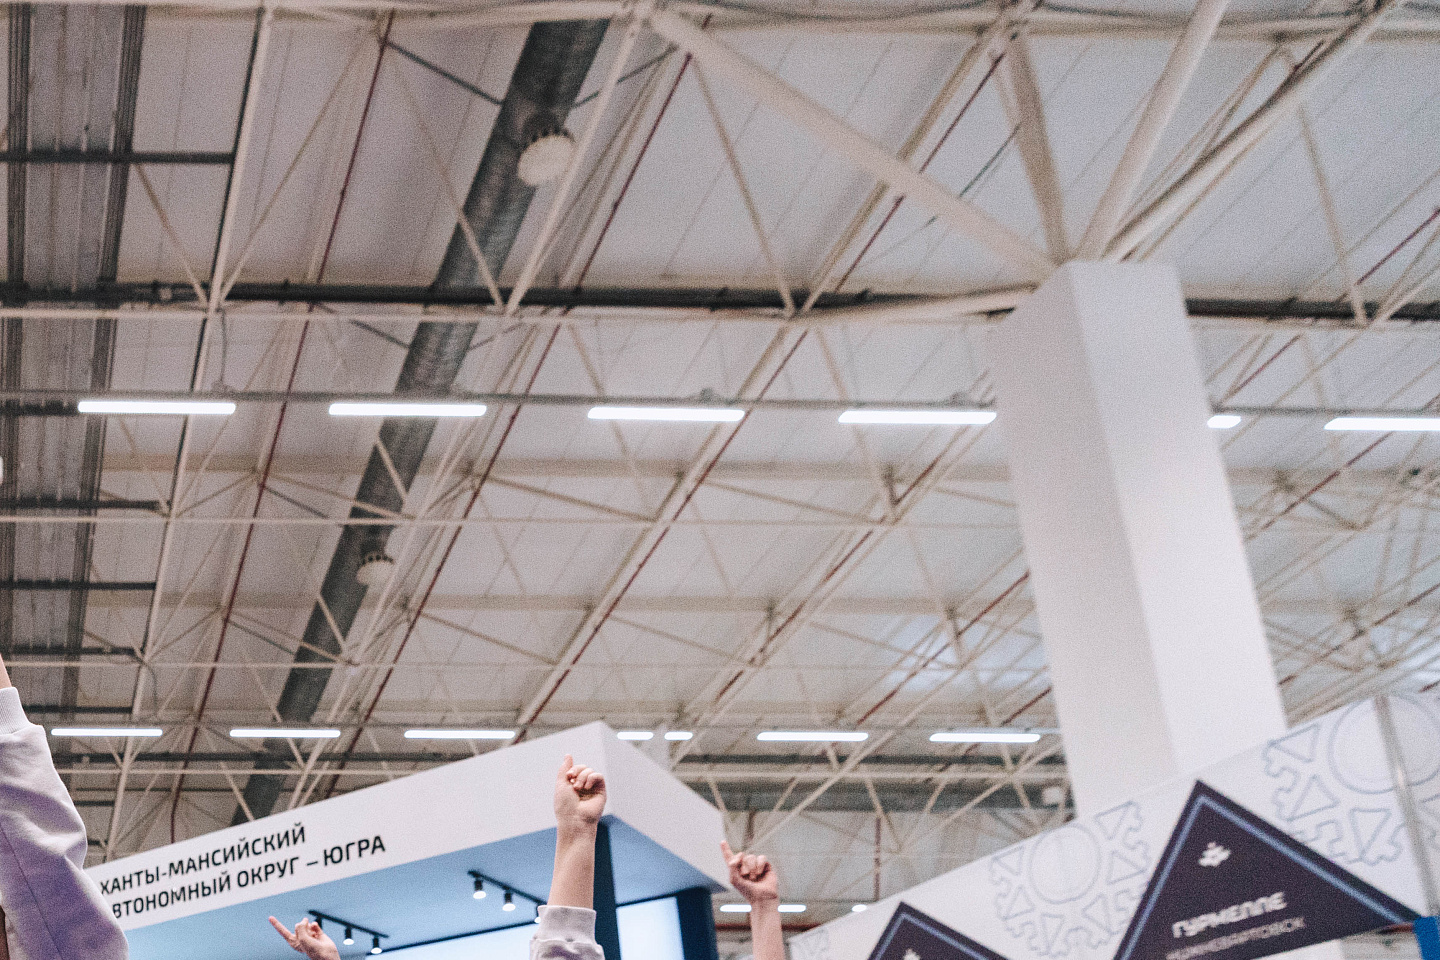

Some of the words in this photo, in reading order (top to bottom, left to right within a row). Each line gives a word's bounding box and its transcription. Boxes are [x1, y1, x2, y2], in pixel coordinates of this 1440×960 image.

[100, 822, 306, 895] ХАНТЫ-МАНСИЙСКИЙ
[112, 870, 231, 919] ВТОНОМНЫЙ
[237, 857, 300, 887] ОКРУГ
[323, 835, 386, 867] ЮГРА
